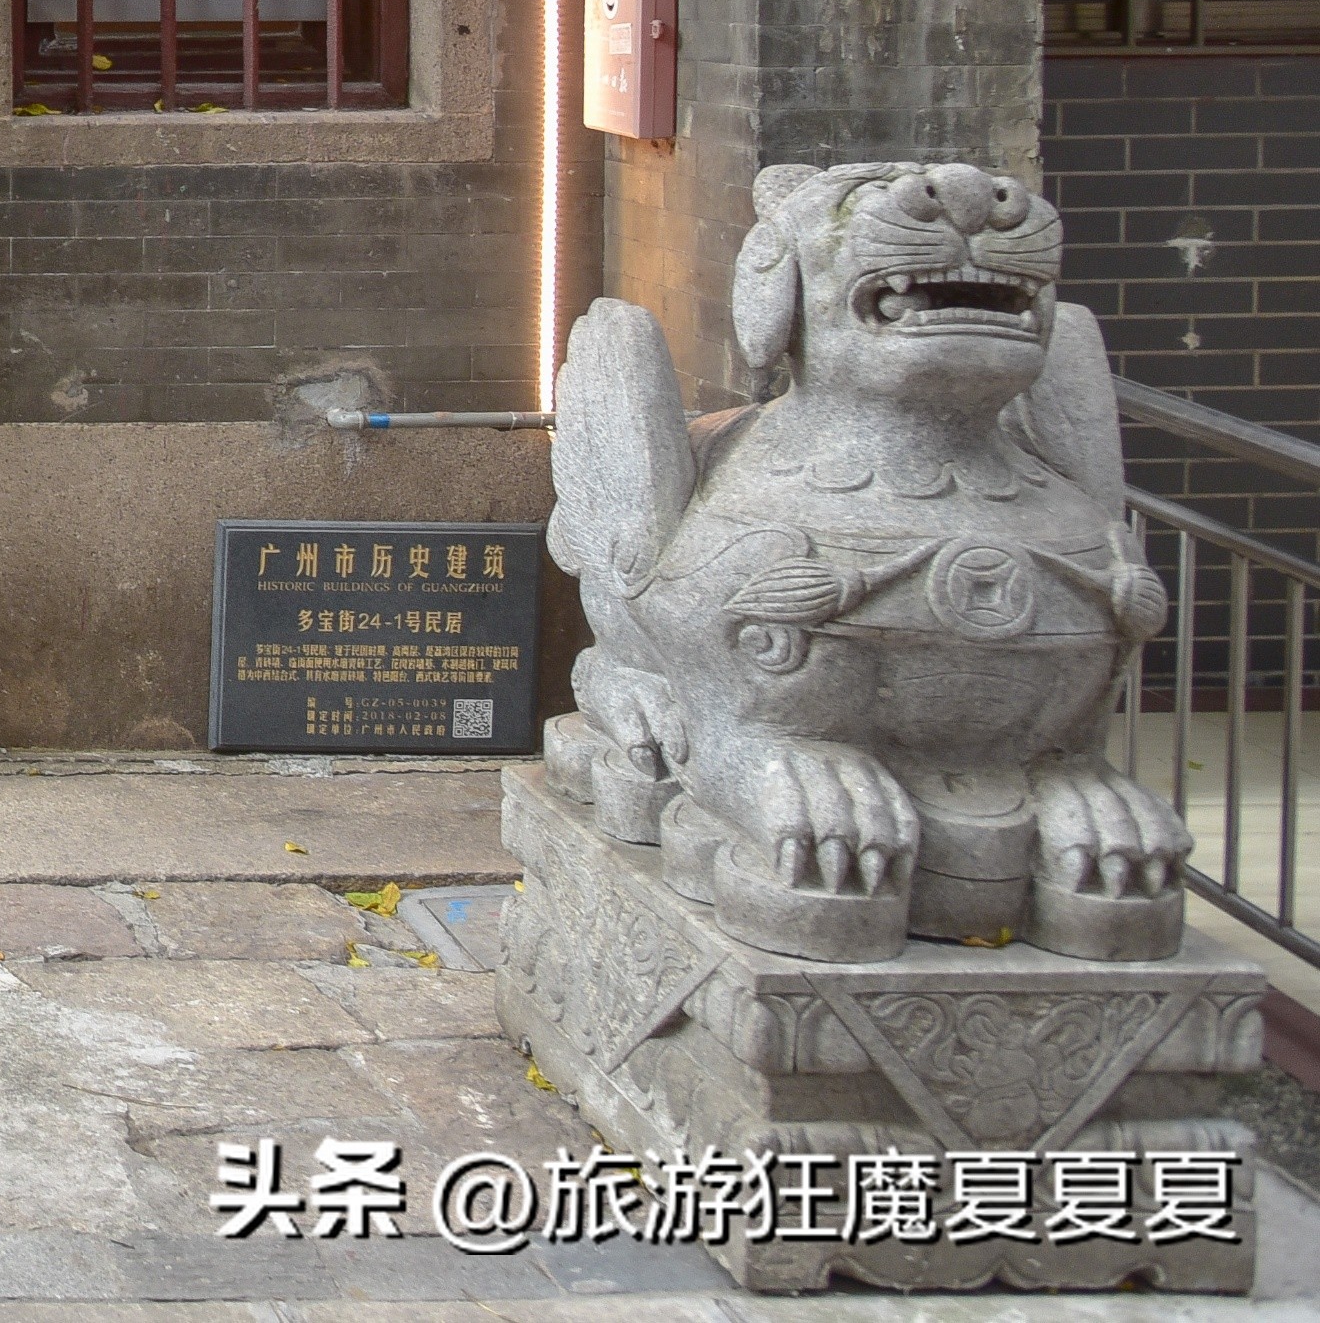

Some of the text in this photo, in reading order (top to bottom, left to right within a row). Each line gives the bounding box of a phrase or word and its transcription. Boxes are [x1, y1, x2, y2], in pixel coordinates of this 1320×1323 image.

[258, 543, 506, 579] 广州市历史建筑
[257, 580, 505, 594] HISTORIC BUILDINGS OF GUANGZHOU
[297, 609, 463, 634] 多宝街24-1号民居
